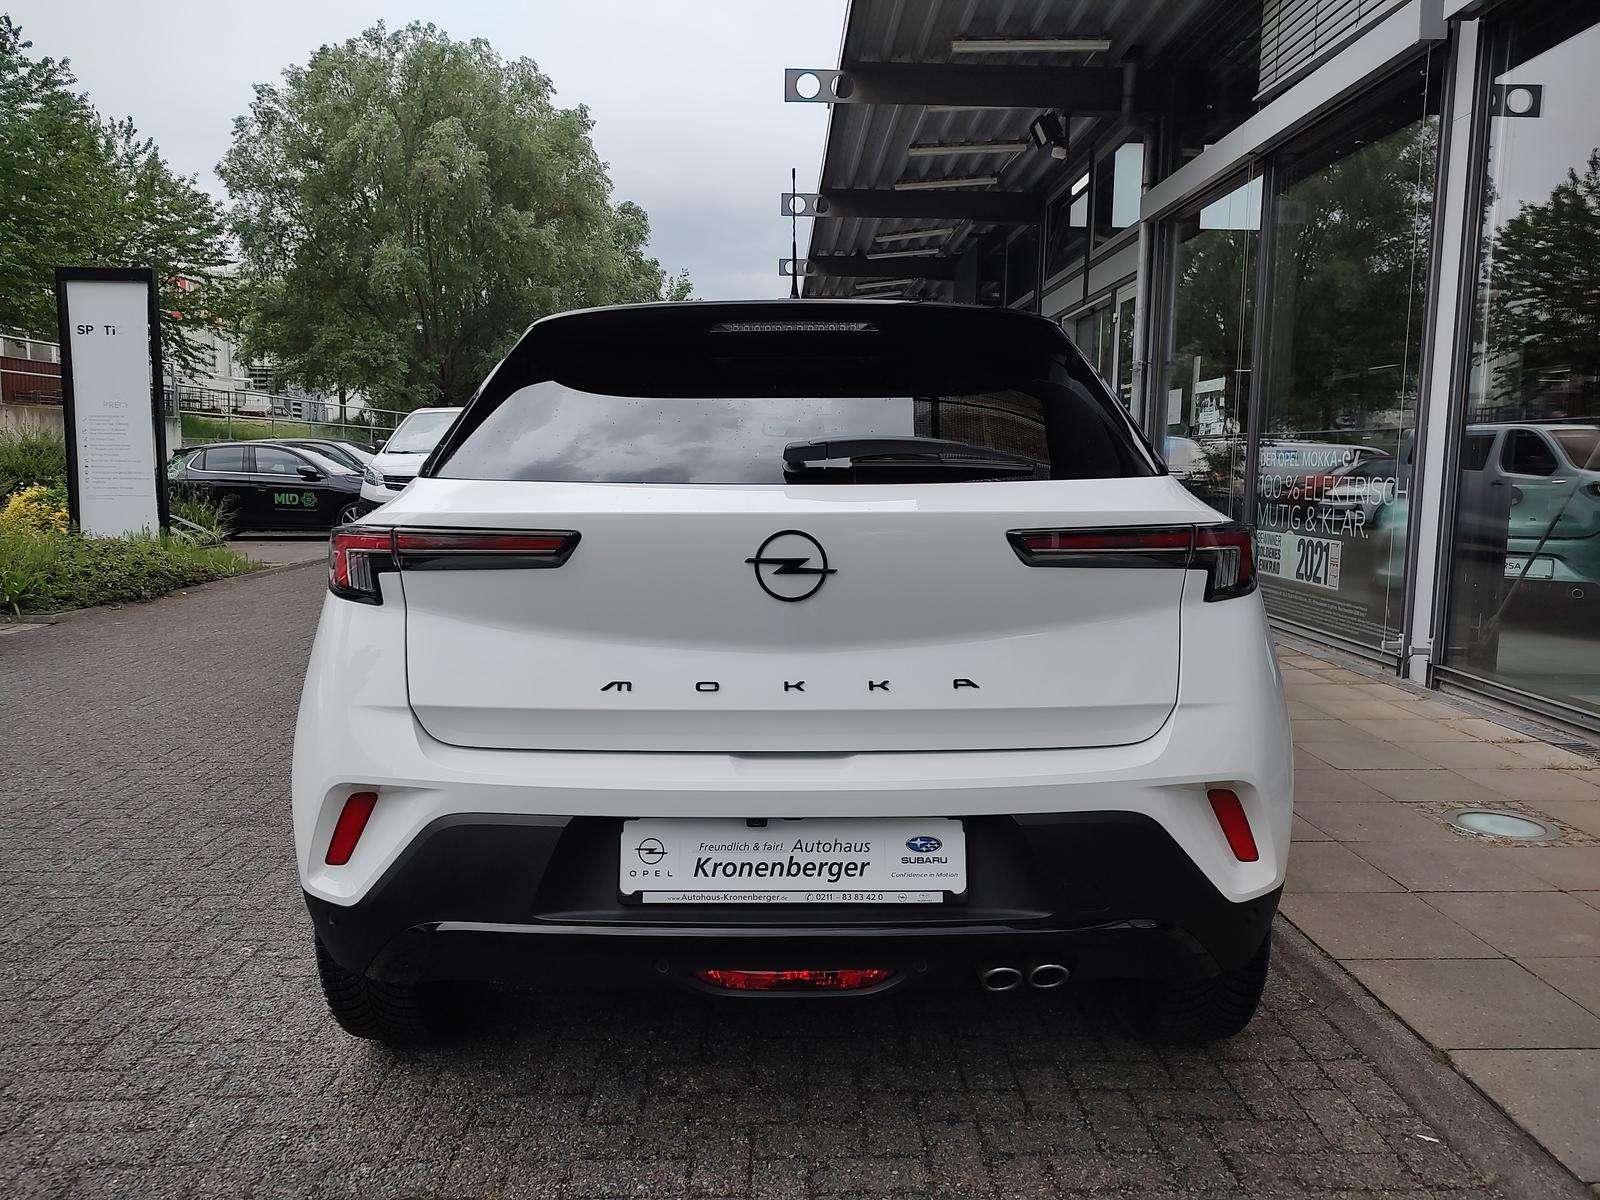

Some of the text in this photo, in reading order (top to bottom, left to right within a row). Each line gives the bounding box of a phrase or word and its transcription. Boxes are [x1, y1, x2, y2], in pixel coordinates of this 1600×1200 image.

[1260, 451, 1277, 467] DER
[1278, 451, 1300, 467] OPEL
[1258, 474, 1410, 506] 100 % ELEKTRISCH
[1257, 502, 1369, 539] MUTIG & KLAR.
[1258, 558, 1281, 575] ENKRAD
[1295, 538, 1330, 586] 2021
[600, 678, 981, 693] MOKKA
[698, 838, 871, 854] Freundlich & fair! Autohaus
[901, 856, 948, 865] SUBARU
[629, 869, 673, 878] OPEL
[693, 855, 871, 884] Kronenberger
[890, 871, 928, 879] Confidence
[815, 893, 833, 901] 0211
[842, 893, 852, 901] 83
[854, 893, 864, 901] 83
[866, 893, 876, 901] 42
[878, 893, 884, 901] 0
